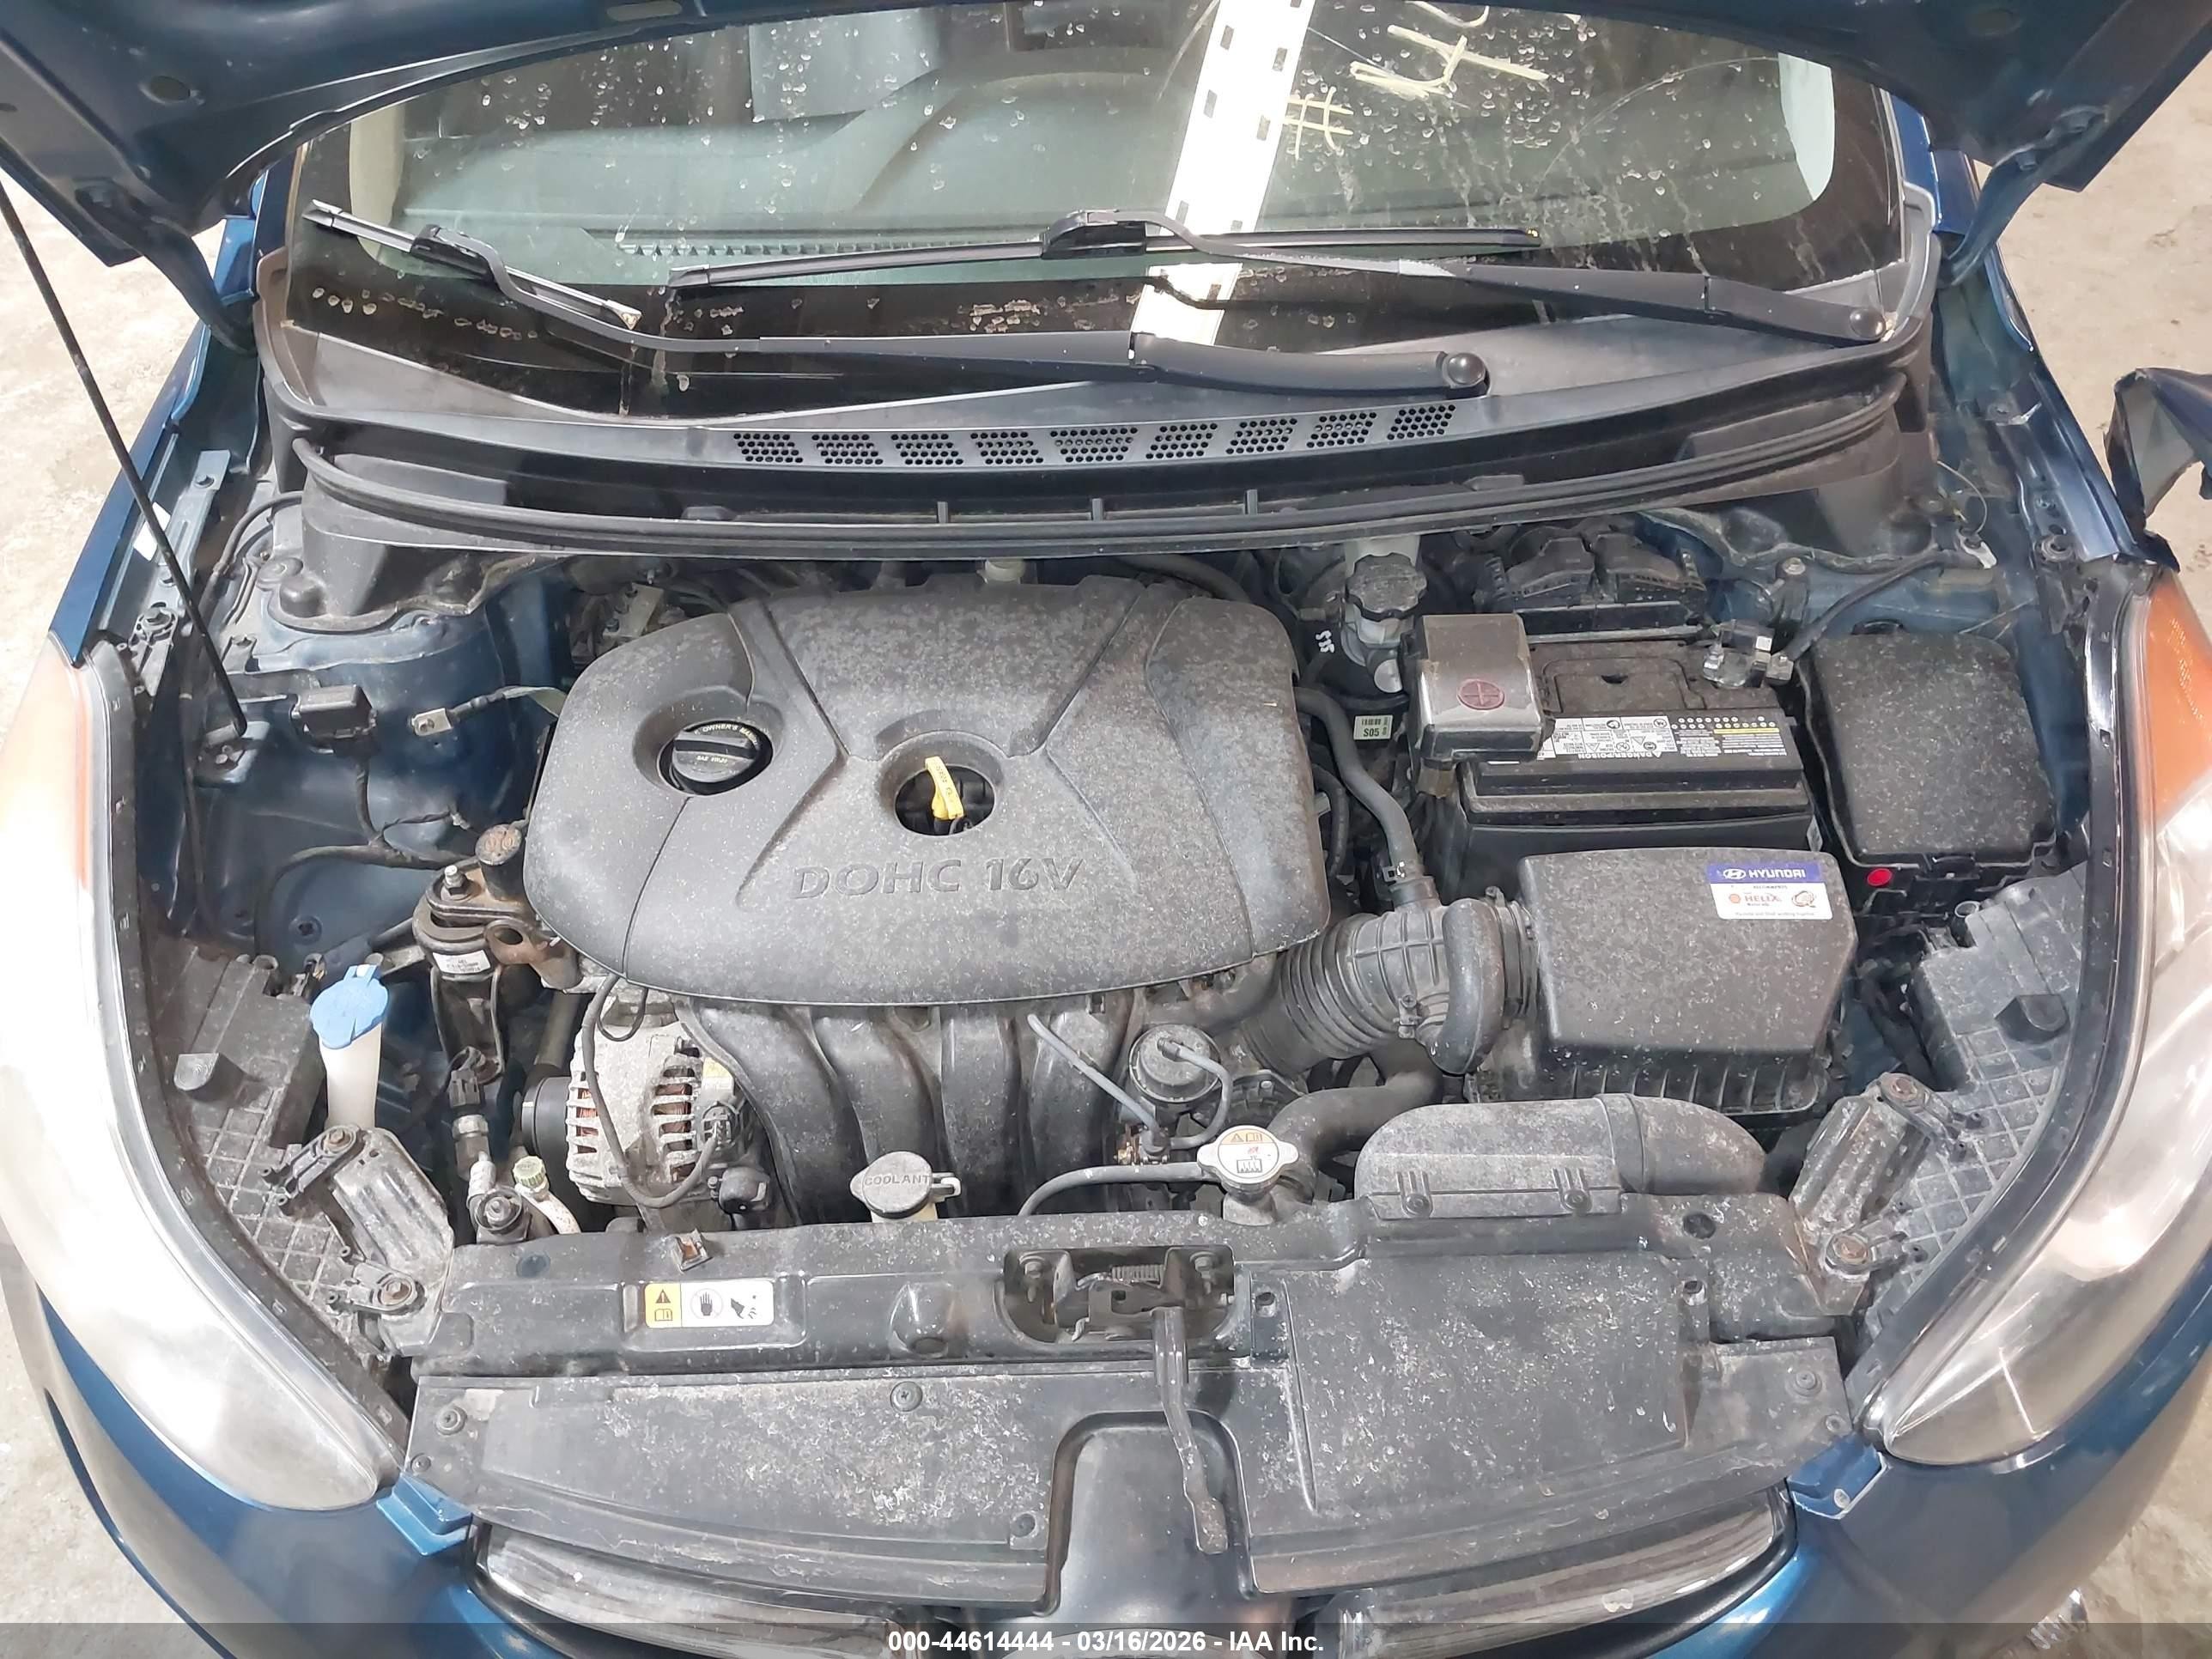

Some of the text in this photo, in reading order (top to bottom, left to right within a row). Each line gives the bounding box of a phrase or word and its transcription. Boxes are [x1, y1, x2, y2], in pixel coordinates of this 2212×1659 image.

[1364, 728, 1380, 738] S05
[793, 857, 1085, 899] DOHC 16V
[1748, 869, 1806, 878] HYUNDAI
[865, 1174, 931, 1186] COOLANT
